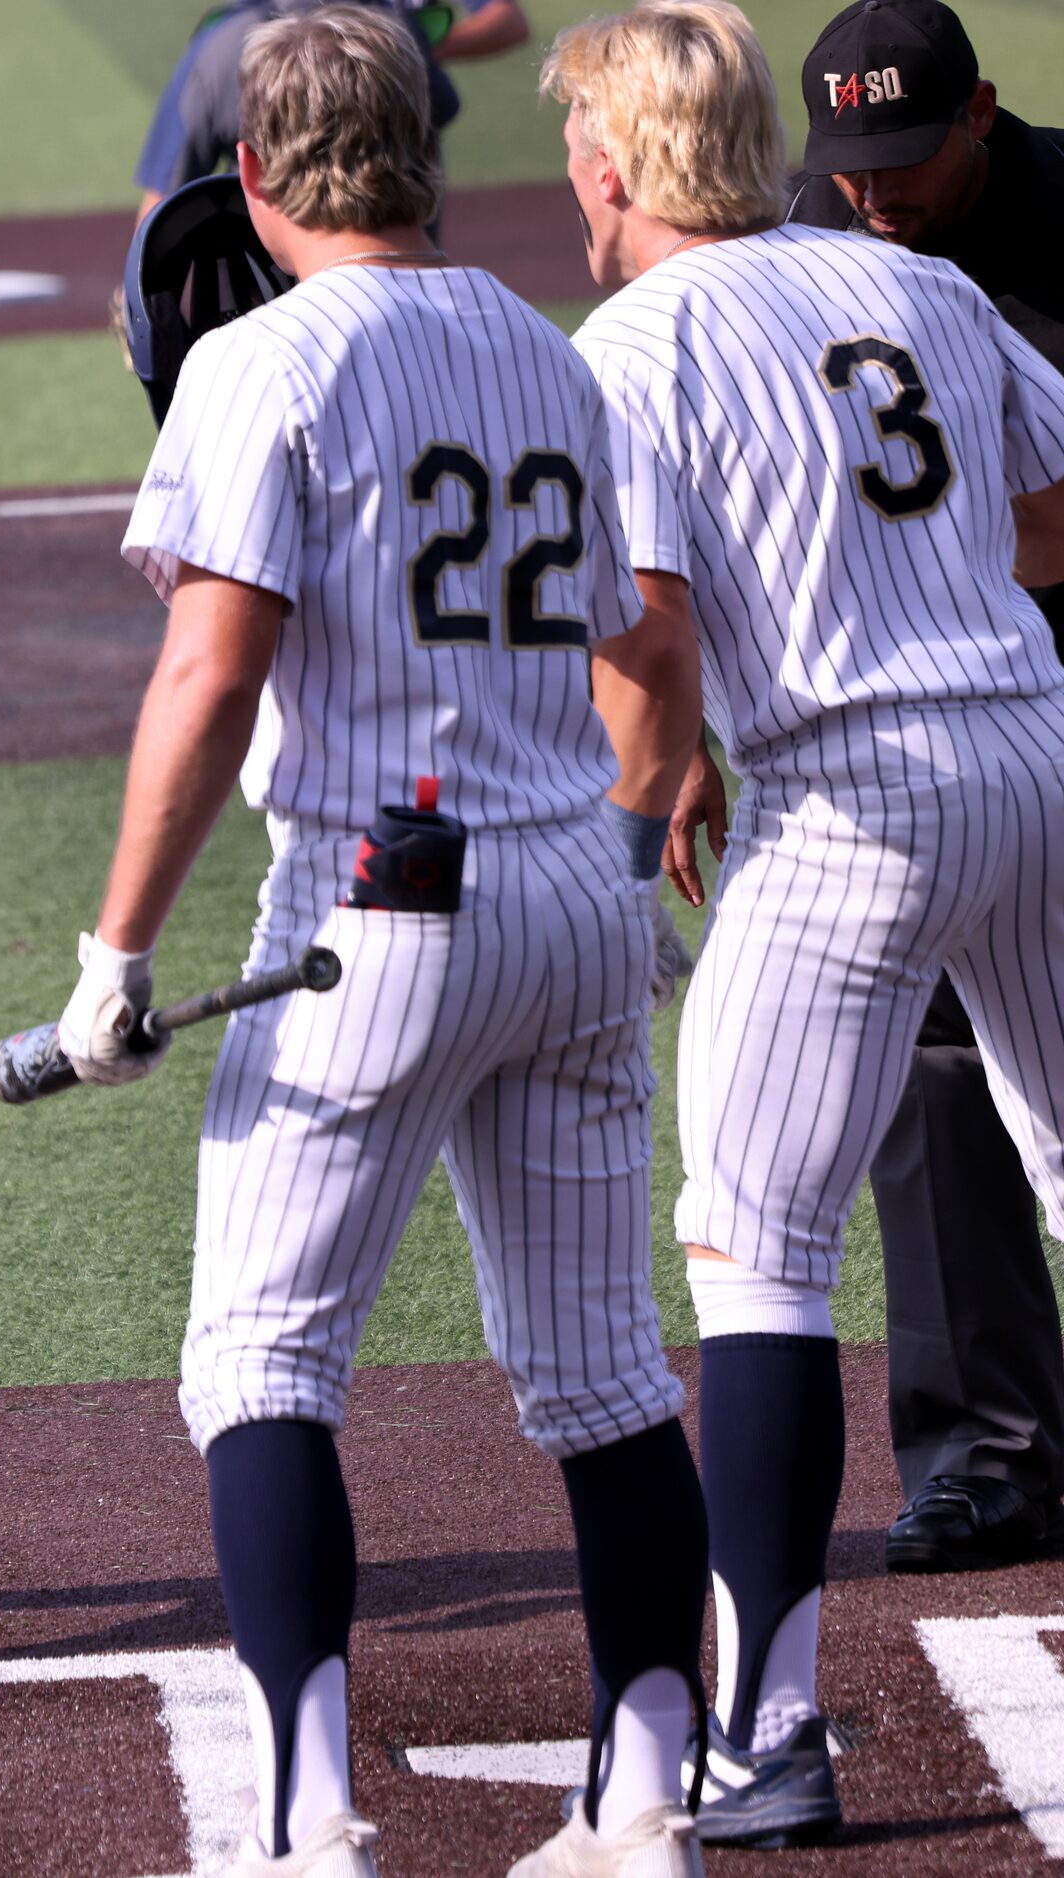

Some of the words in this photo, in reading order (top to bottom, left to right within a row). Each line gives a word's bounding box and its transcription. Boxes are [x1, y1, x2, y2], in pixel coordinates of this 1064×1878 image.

[823, 67, 904, 119] TASO
[817, 332, 957, 524] 3
[405, 440, 589, 652] 22
